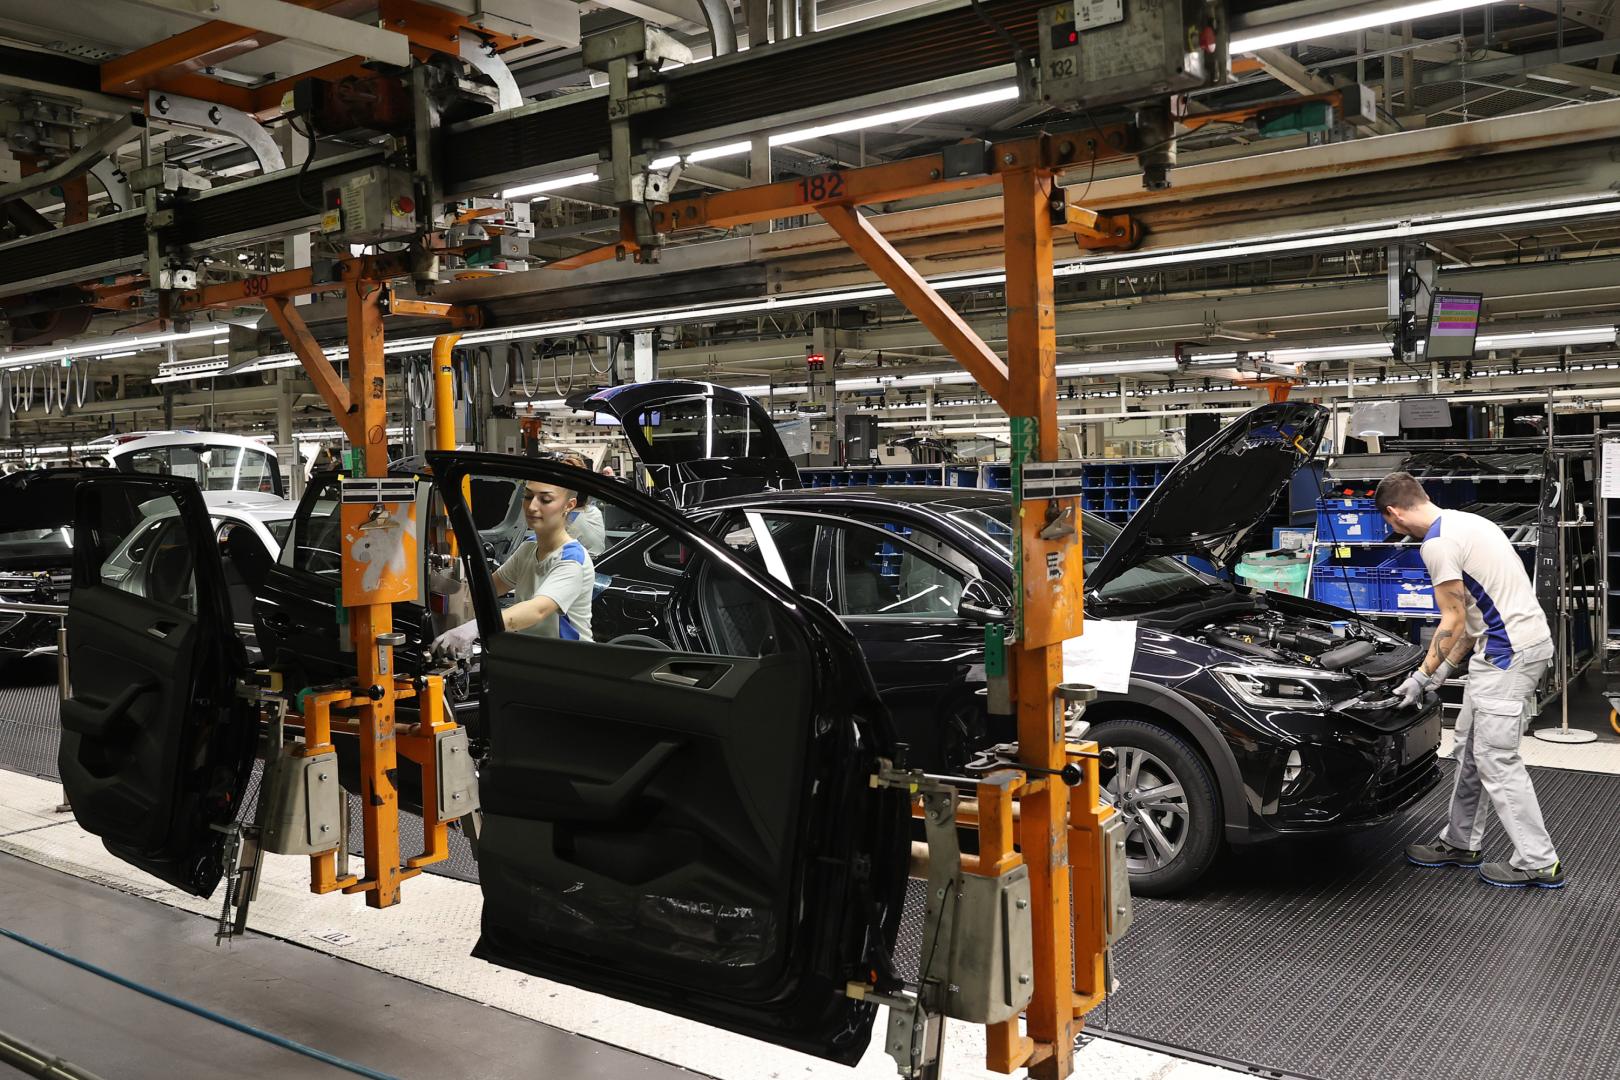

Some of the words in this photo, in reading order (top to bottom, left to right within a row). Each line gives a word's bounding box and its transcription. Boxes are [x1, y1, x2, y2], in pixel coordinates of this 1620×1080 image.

[1050, 58, 1073, 77] 132
[799, 174, 844, 202] 182
[243, 276, 268, 297] 390
[1023, 417, 1033, 432] 2
